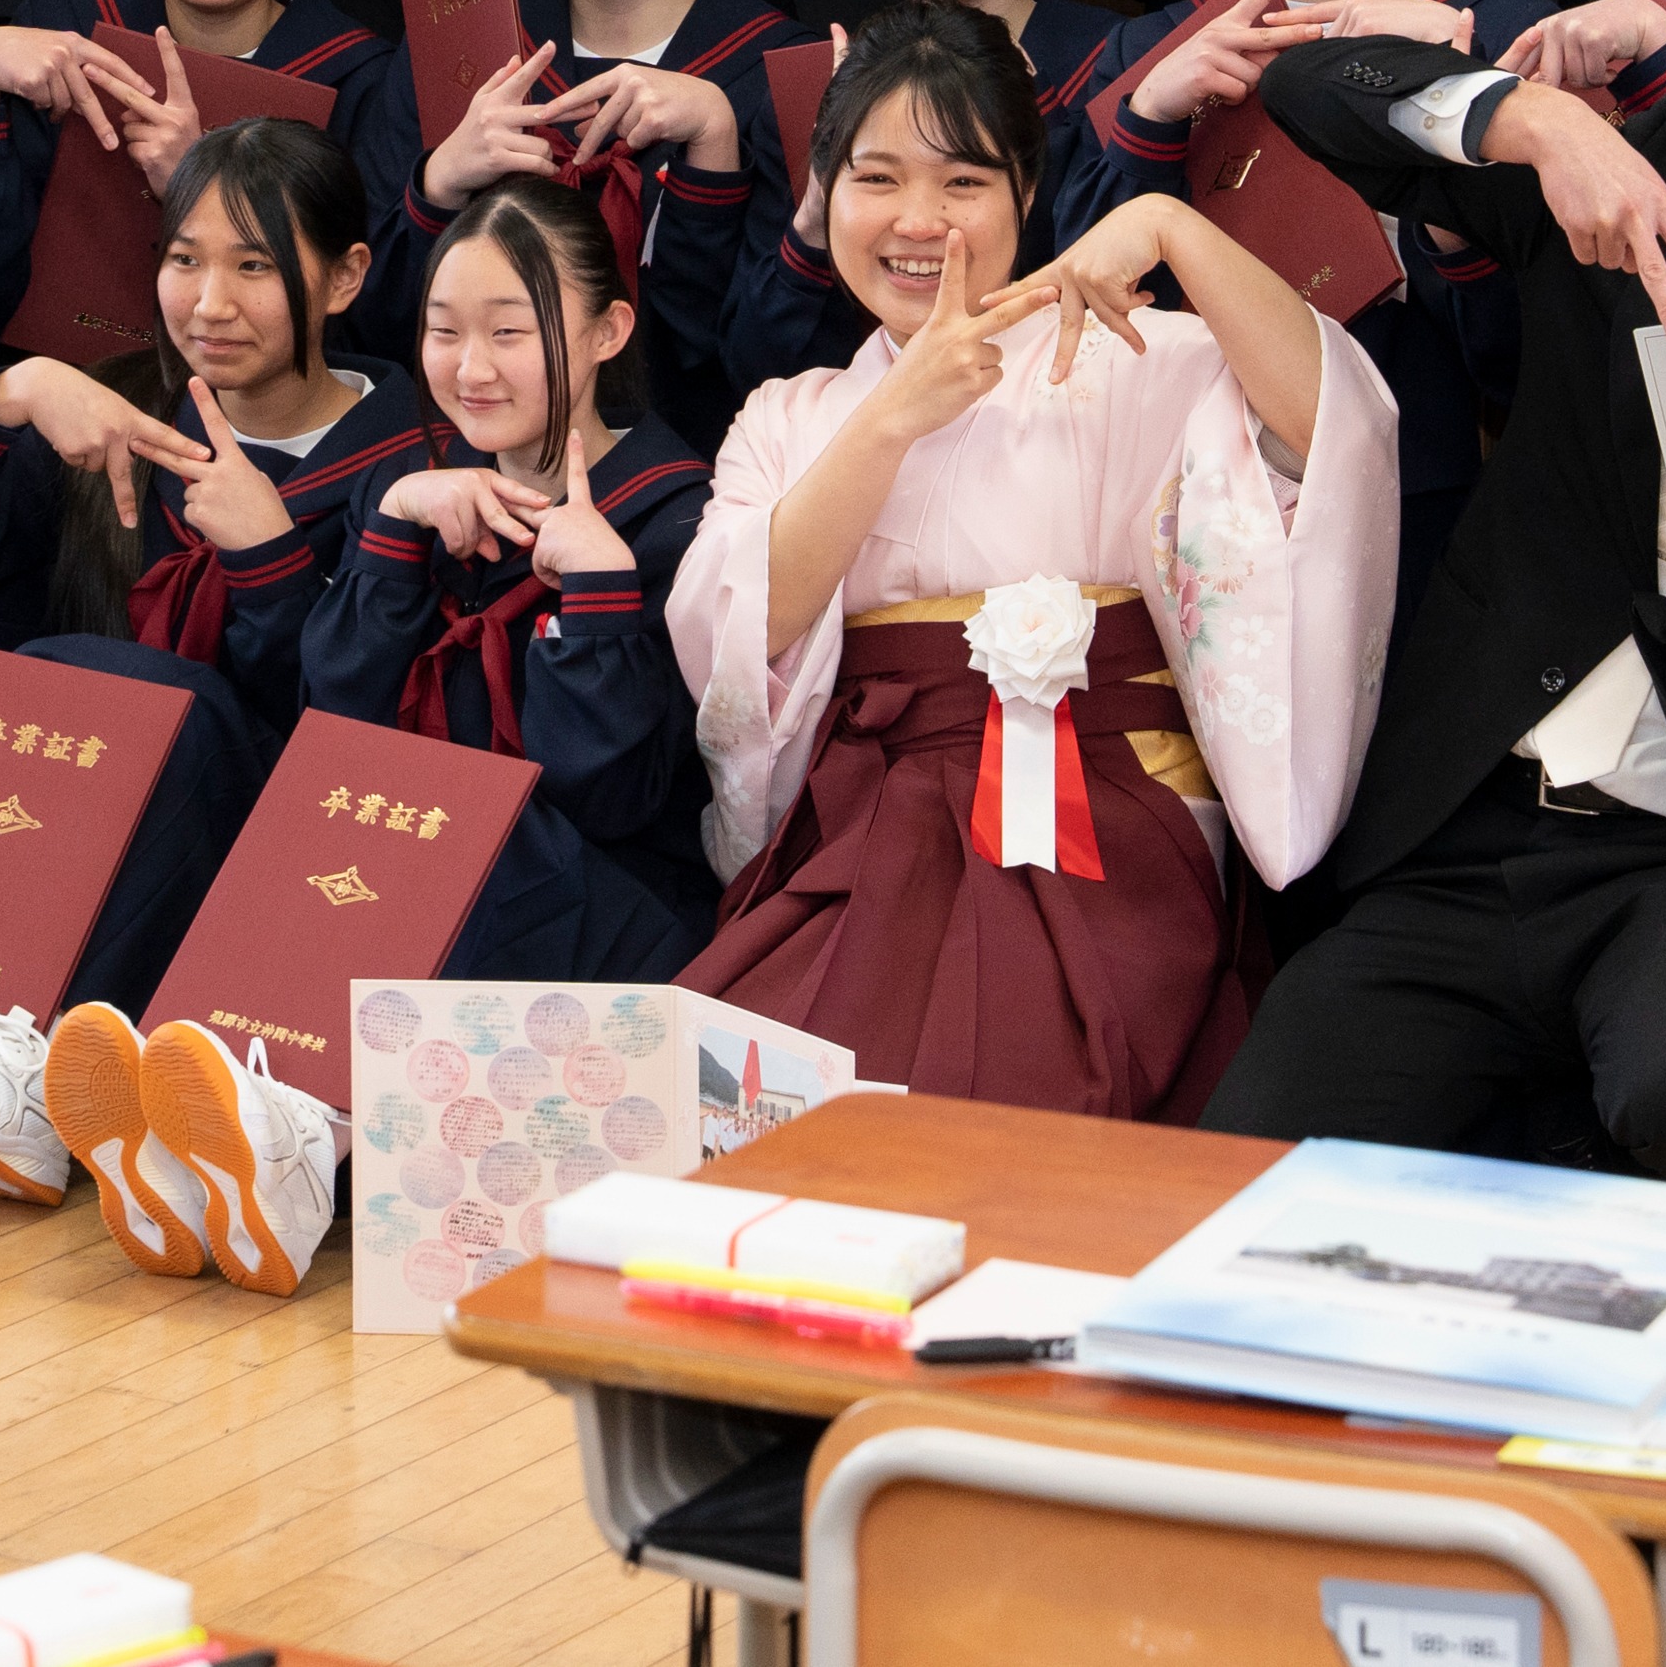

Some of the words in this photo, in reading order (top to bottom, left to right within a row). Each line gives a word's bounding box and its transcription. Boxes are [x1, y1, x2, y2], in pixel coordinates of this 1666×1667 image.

[319, 786, 452, 841] 卒業証書
[1359, 1616, 1383, 1660] L
